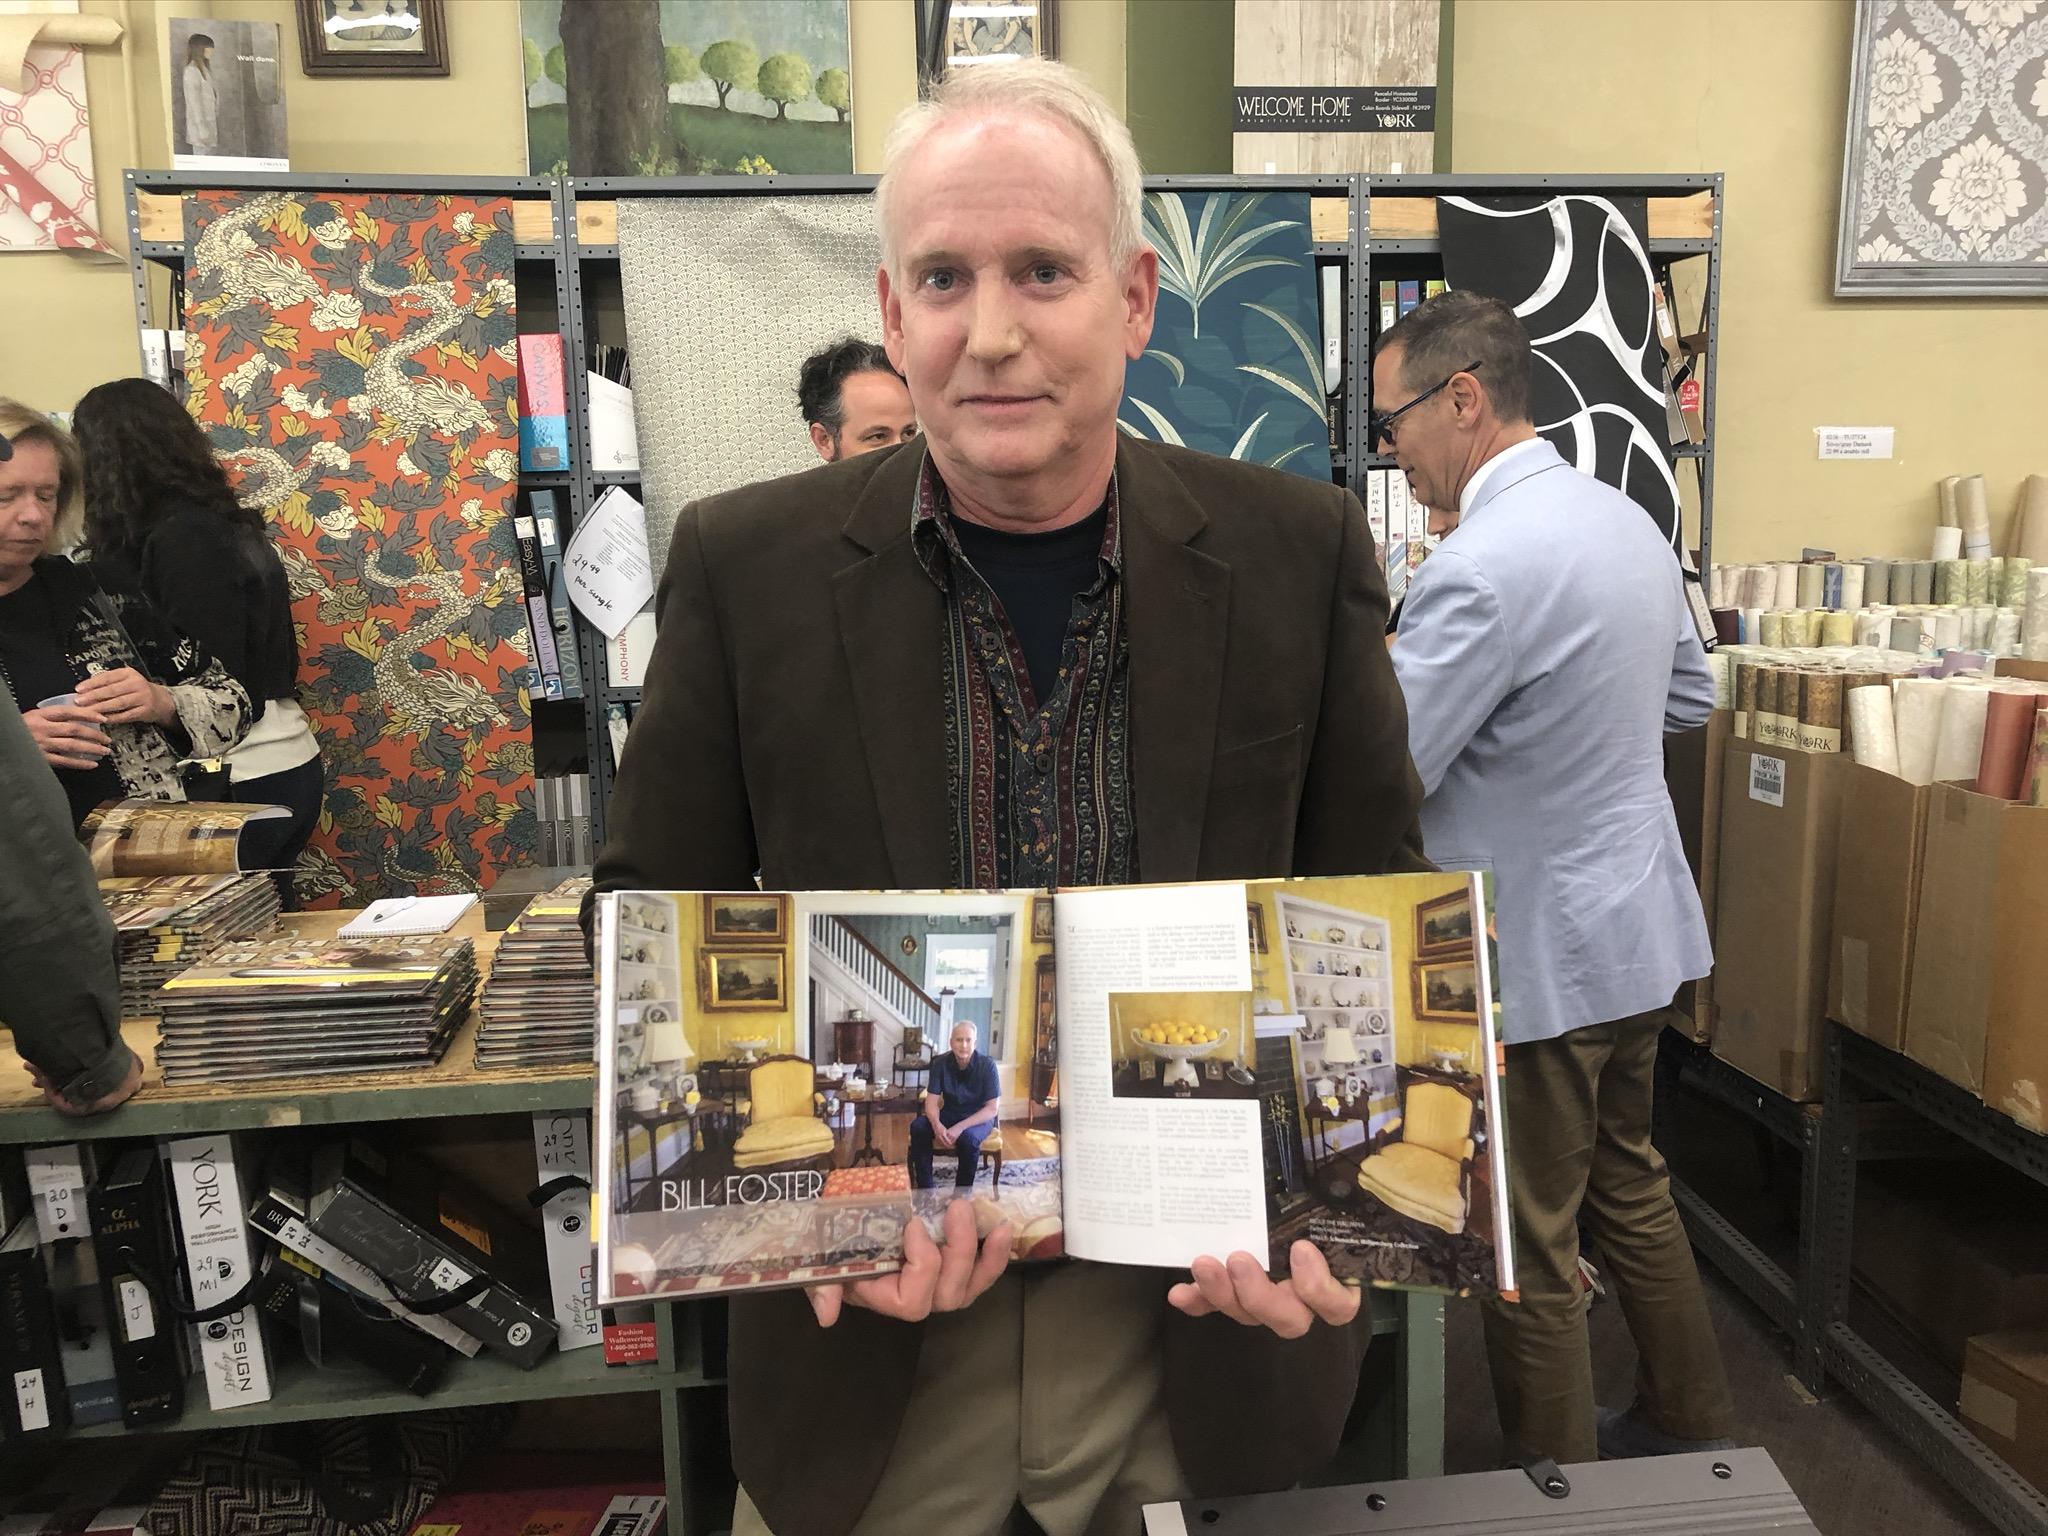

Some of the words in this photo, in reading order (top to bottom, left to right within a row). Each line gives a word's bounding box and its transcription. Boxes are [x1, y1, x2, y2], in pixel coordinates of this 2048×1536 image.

[1238, 97, 1305, 116] WELCOME
[1311, 97, 1351, 116] HOME
[1376, 114, 1416, 128] YORK
[532, 343, 549, 408] CANVAS
[574, 575, 588, 590] per
[588, 588, 615, 612] single
[191, 1148, 223, 1220] YORK
[661, 1180, 716, 1213] BILL
[725, 1169, 823, 1206] FOSTER
[227, 1311, 252, 1392] DESIGN
[618, 1328, 644, 1336] Fashion
